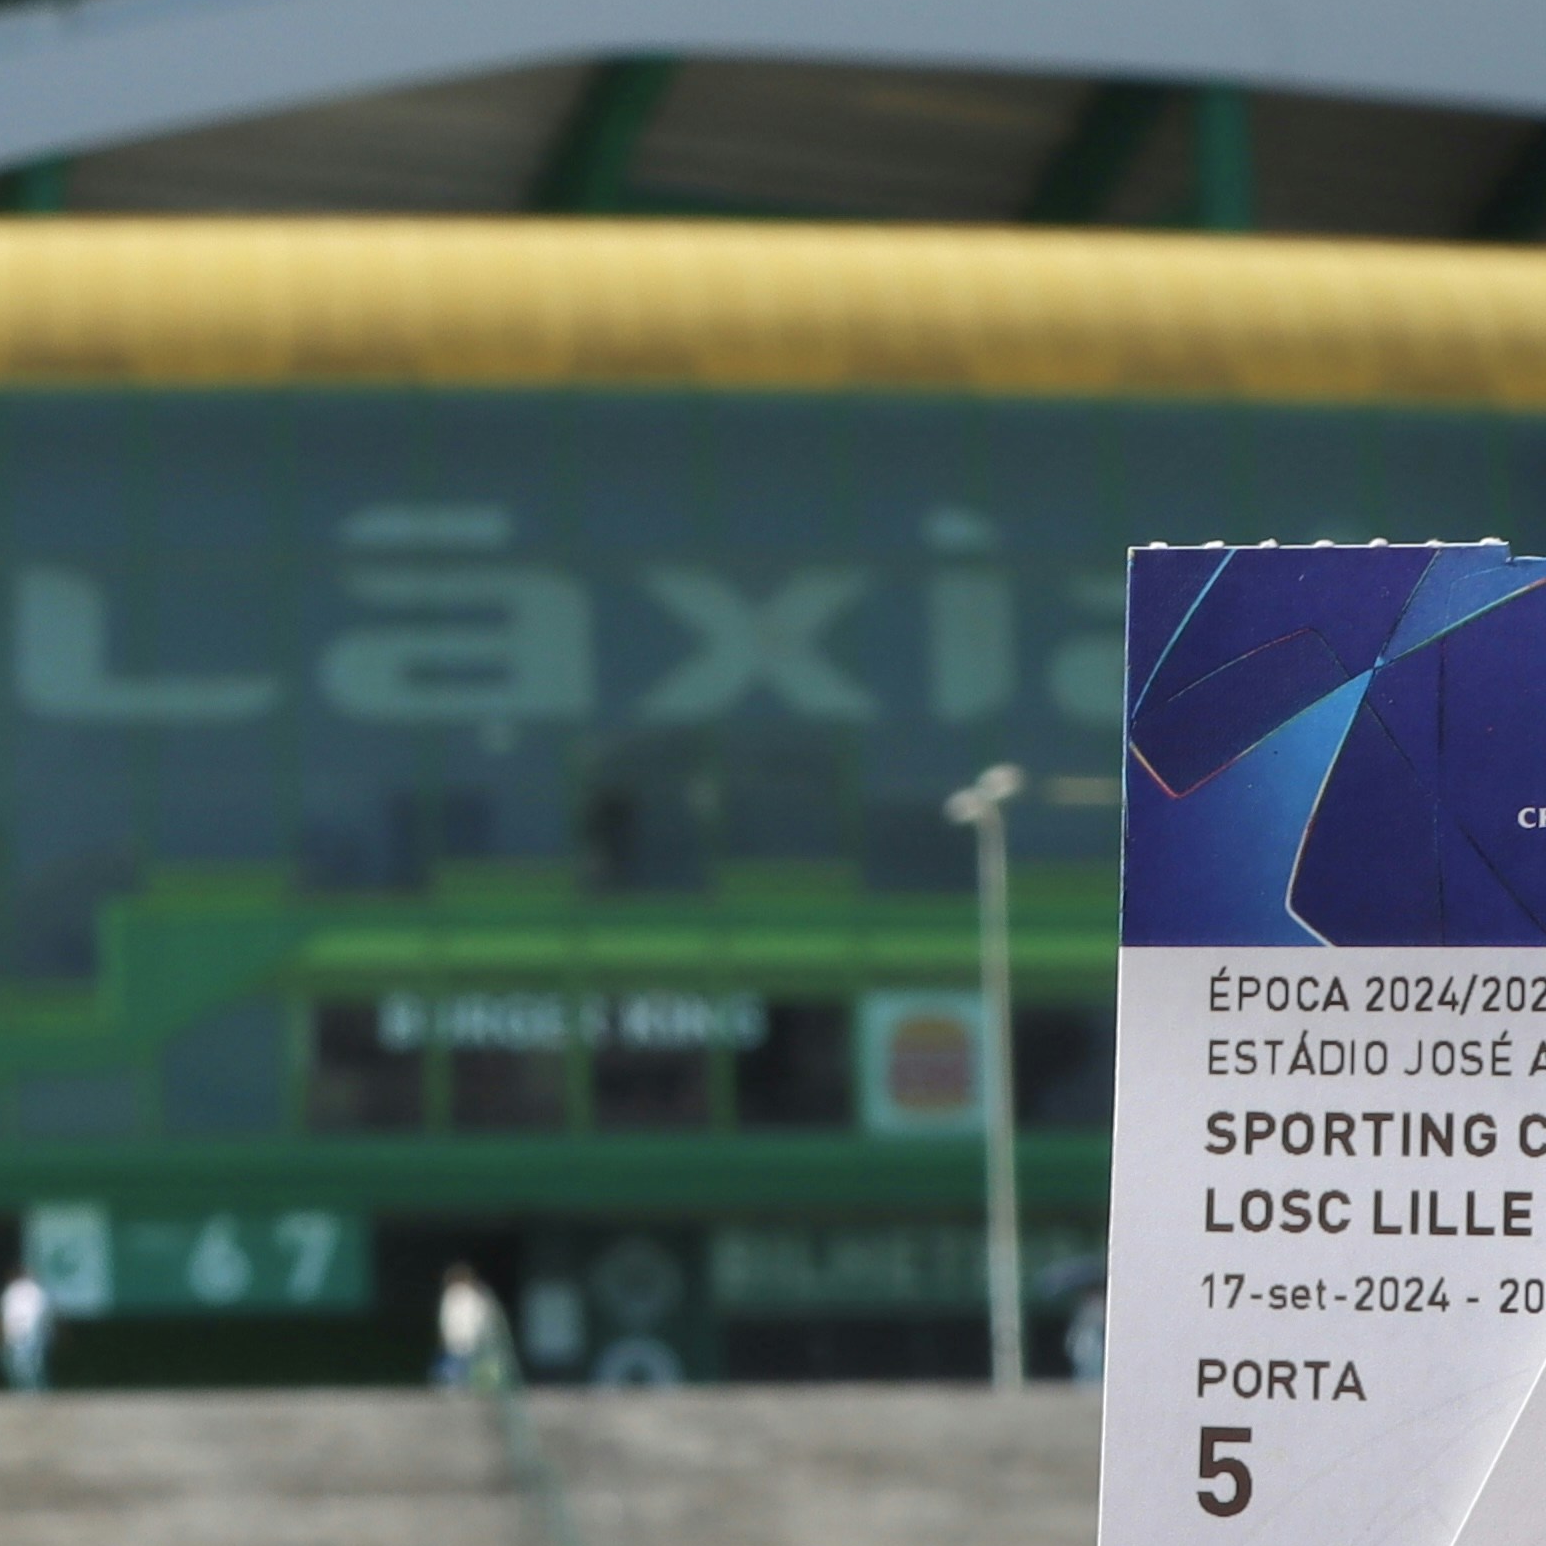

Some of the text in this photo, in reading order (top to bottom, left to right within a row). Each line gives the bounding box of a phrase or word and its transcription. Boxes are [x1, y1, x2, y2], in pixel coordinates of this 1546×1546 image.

[1209, 965, 1350, 1013] ÉPOCA
[1208, 1029, 1388, 1076] ESTÁDIO
[1403, 1029, 1513, 1077] JOSÉ
[1204, 1110, 1497, 1158] SPORTING
[1205, 1187, 1534, 1237] LOSC LILLE
[1201, 1273, 1450, 1313] 17-set-2024
[1197, 1358, 1367, 1402] PORTA
[1196, 1425, 1253, 1518] 5
